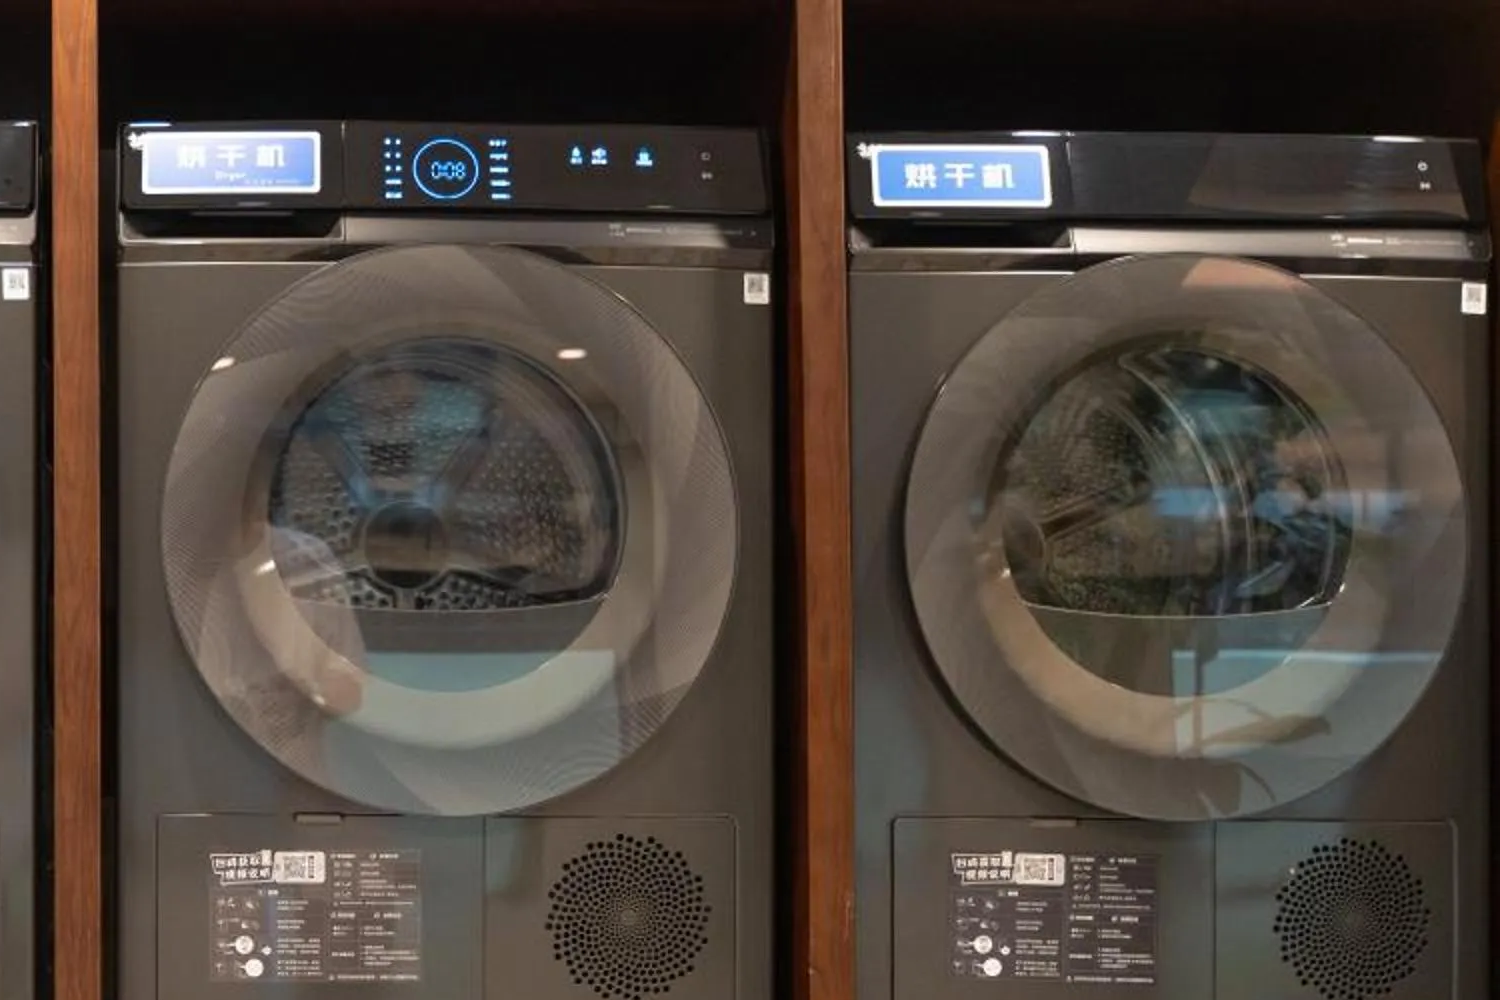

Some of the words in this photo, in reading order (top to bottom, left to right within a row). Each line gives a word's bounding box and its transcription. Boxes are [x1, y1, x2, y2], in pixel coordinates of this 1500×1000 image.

[176, 144, 285, 168] 烘干机
[904, 163, 1015, 189] 烘干机
